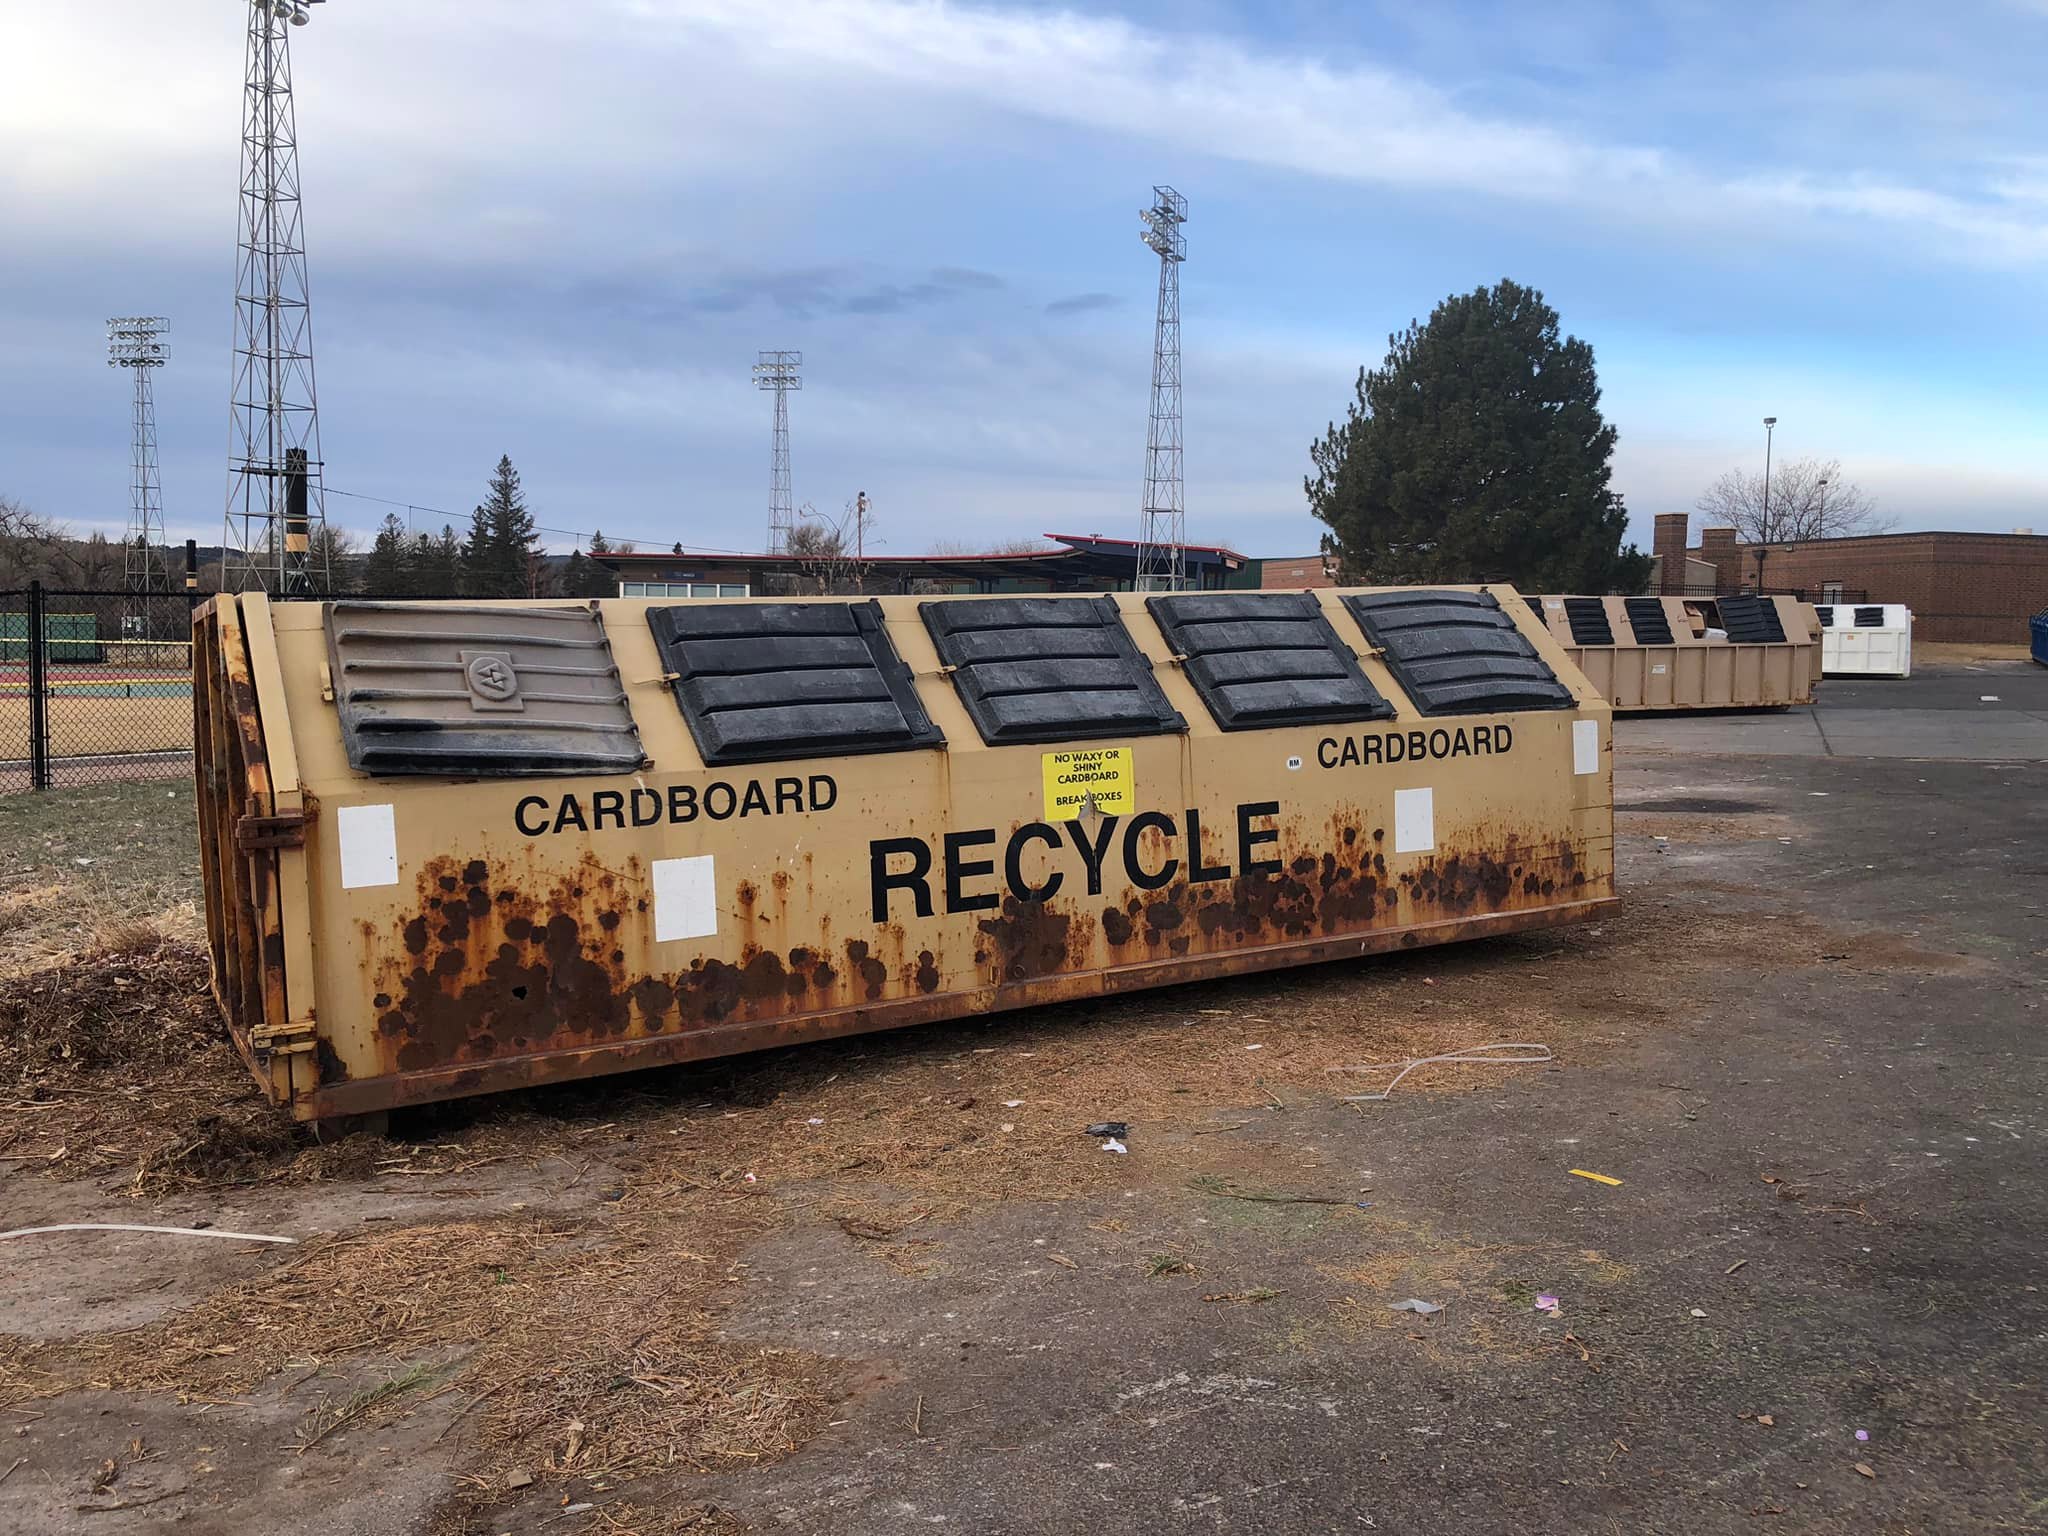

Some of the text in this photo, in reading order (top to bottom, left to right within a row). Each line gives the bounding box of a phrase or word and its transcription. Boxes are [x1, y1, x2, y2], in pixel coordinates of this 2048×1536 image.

[1317, 724, 1513, 769] CARDBOARD
[1054, 750, 1119, 763] NO WAXY OR
[1073, 762, 1103, 772] SHINY
[1057, 771, 1119, 784] CARDBOARD
[515, 774, 837, 837] CARDBOARD
[1056, 794, 1088, 806] BREAK
[869, 801, 1282, 923] RECYCLE
